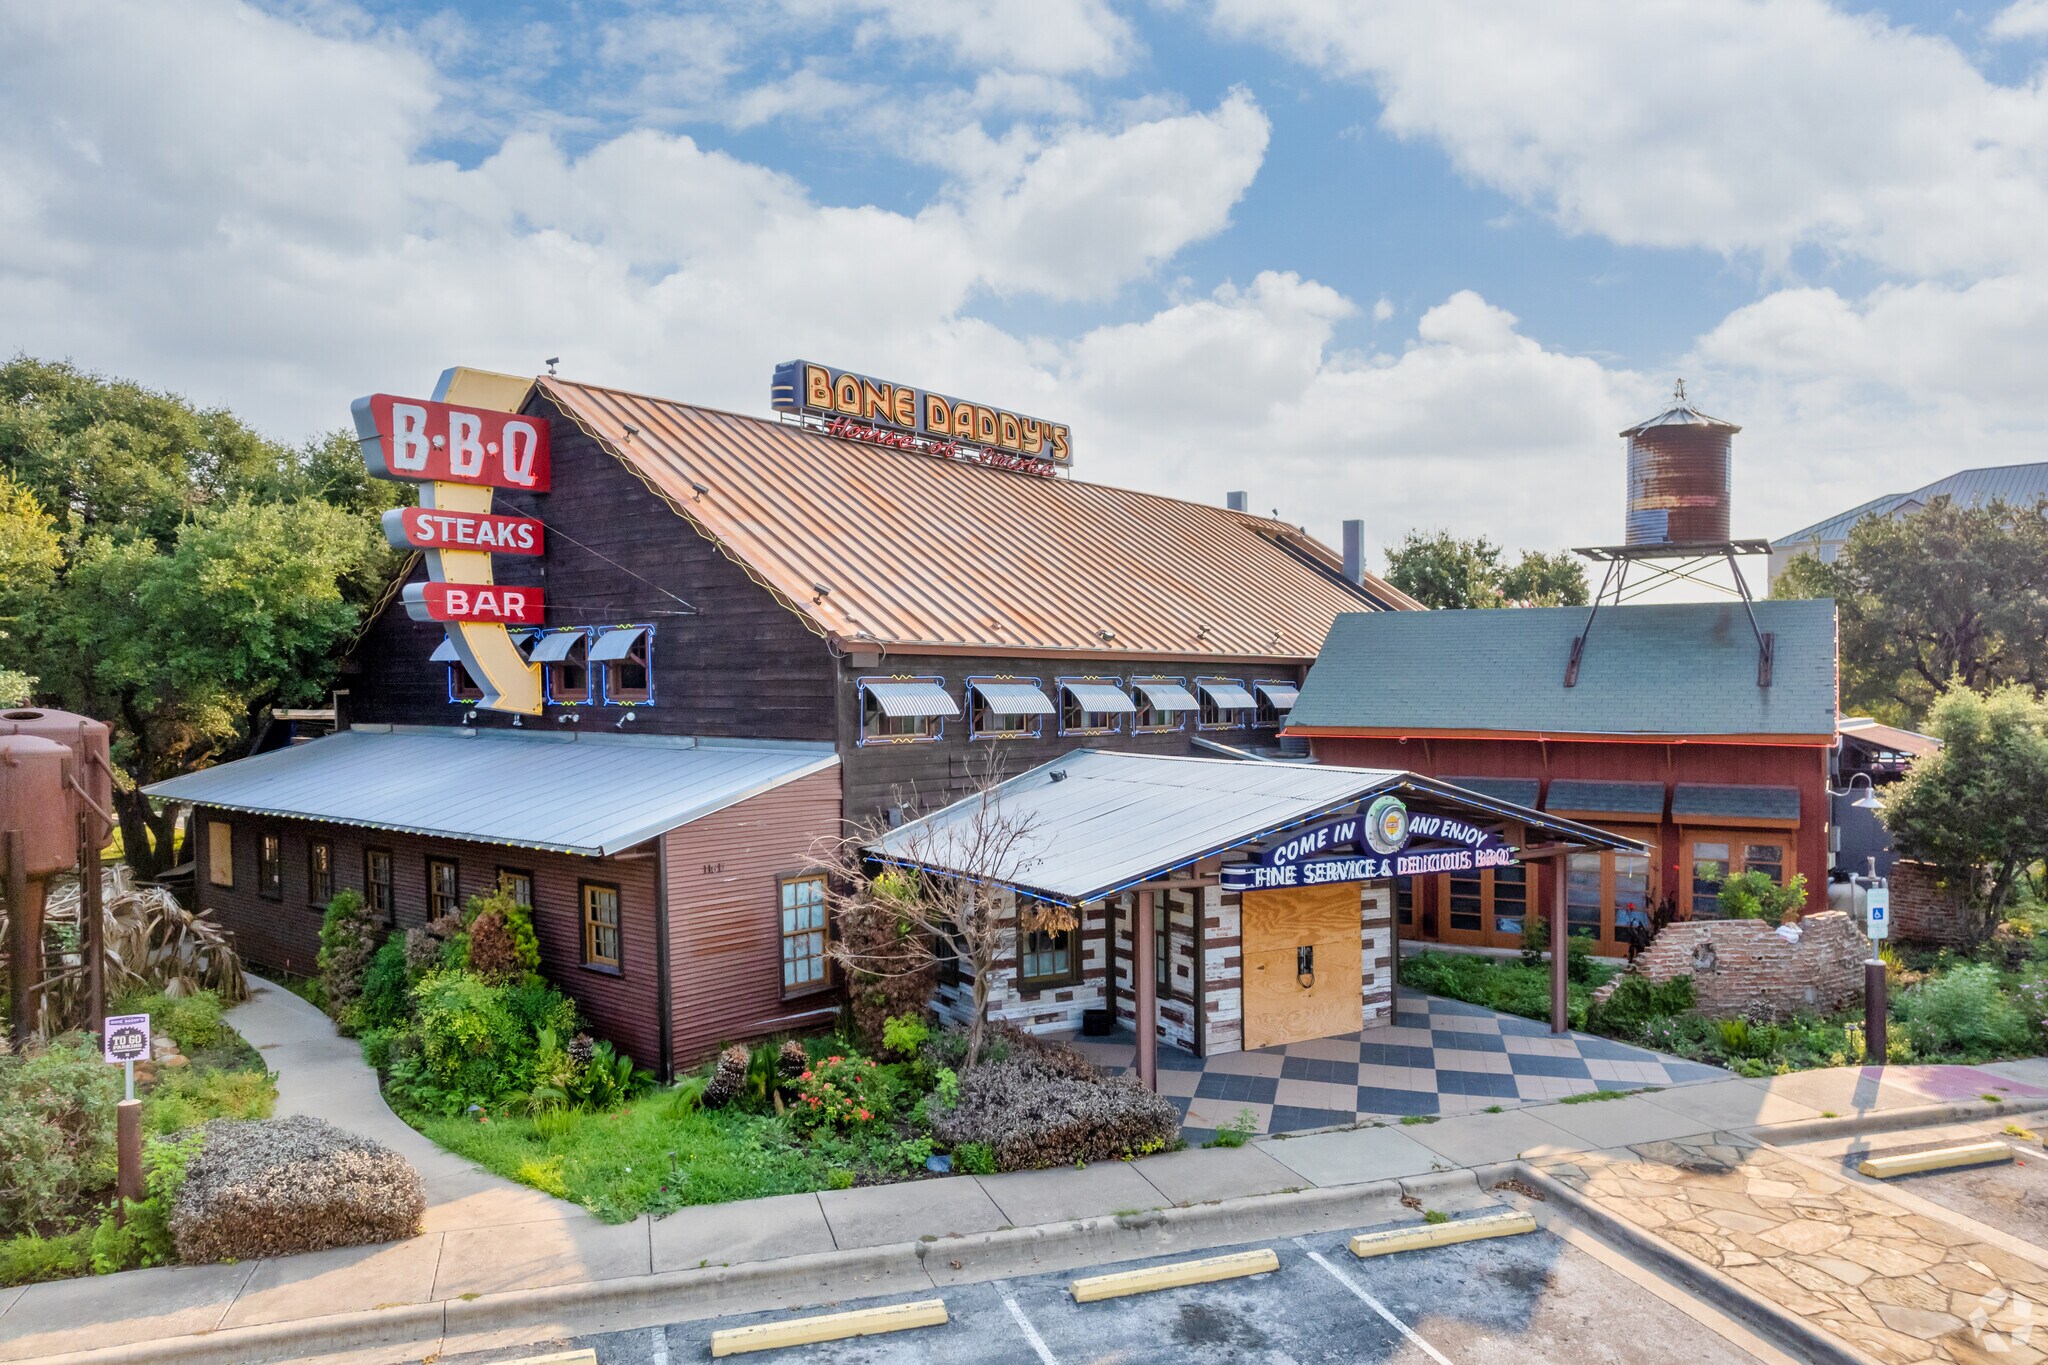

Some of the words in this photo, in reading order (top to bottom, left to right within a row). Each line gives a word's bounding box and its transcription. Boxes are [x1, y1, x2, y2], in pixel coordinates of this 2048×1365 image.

[805, 363, 917, 428] BONE
[925, 392, 1071, 460] DADDY'S
[825, 416, 917, 449] House
[928, 441, 962, 458] of
[971, 447, 1057, 477] Smoke
[415, 514, 535, 549] STEAKS
[446, 589, 526, 620] BAR
[1273, 827, 1329, 866] COME
[1333, 821, 1356, 843] IN
[1408, 815, 1441, 836] AND
[1440, 820, 1488, 848] ENJOY
[1254, 864, 1298, 887] FINE
[1303, 858, 1378, 884] SERVICE
[1380, 858, 1394, 877] &
[1397, 850, 1473, 876] DELICIOUS
[1475, 847, 1509, 868] BBQ
[112, 1036, 127, 1046] TO
[128, 1034, 142, 1044] GO
